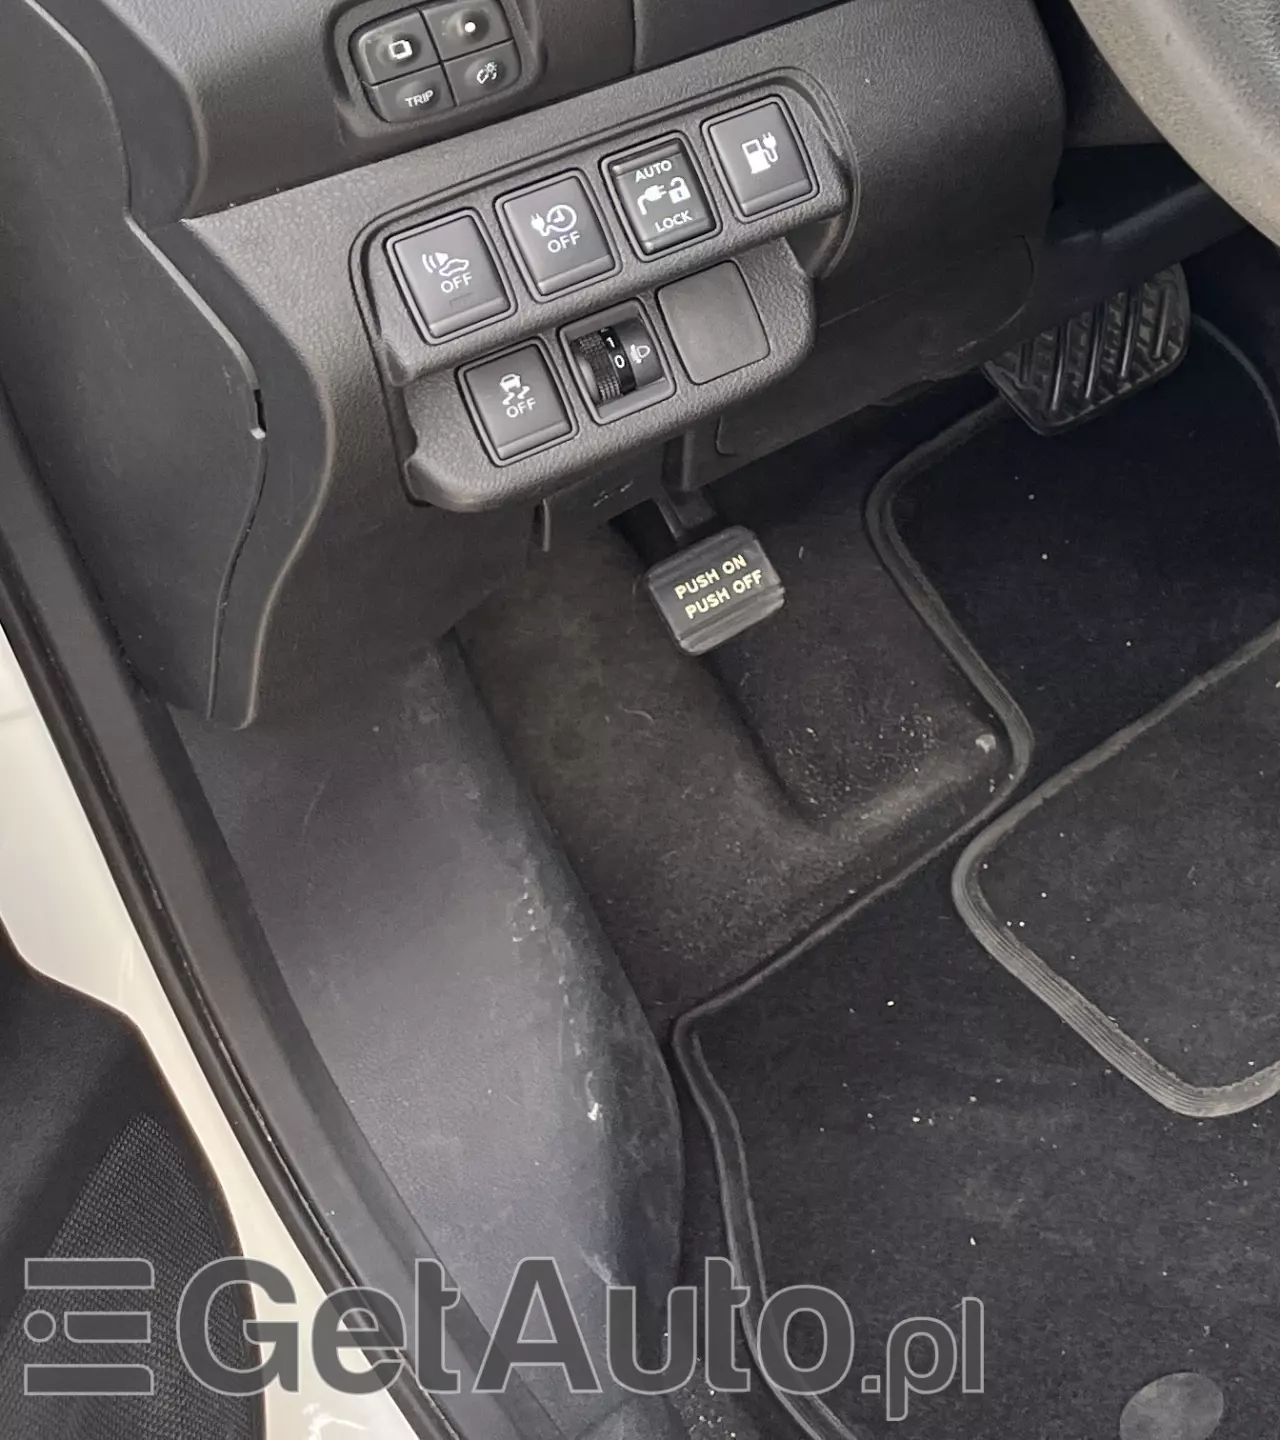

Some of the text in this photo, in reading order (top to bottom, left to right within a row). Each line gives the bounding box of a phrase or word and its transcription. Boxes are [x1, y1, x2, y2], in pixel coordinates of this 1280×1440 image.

[405, 89, 434, 107] TRIP
[634, 160, 673, 182] AUTO
[655, 210, 693, 233] LOCK
[547, 233, 581, 254] OFF
[440, 272, 473, 294] OFF
[614, 354, 625, 368] 0
[506, 398, 537, 419] OFF
[674, 554, 747, 600] PUSH ON
[684, 569, 763, 619] PUSH OFF
